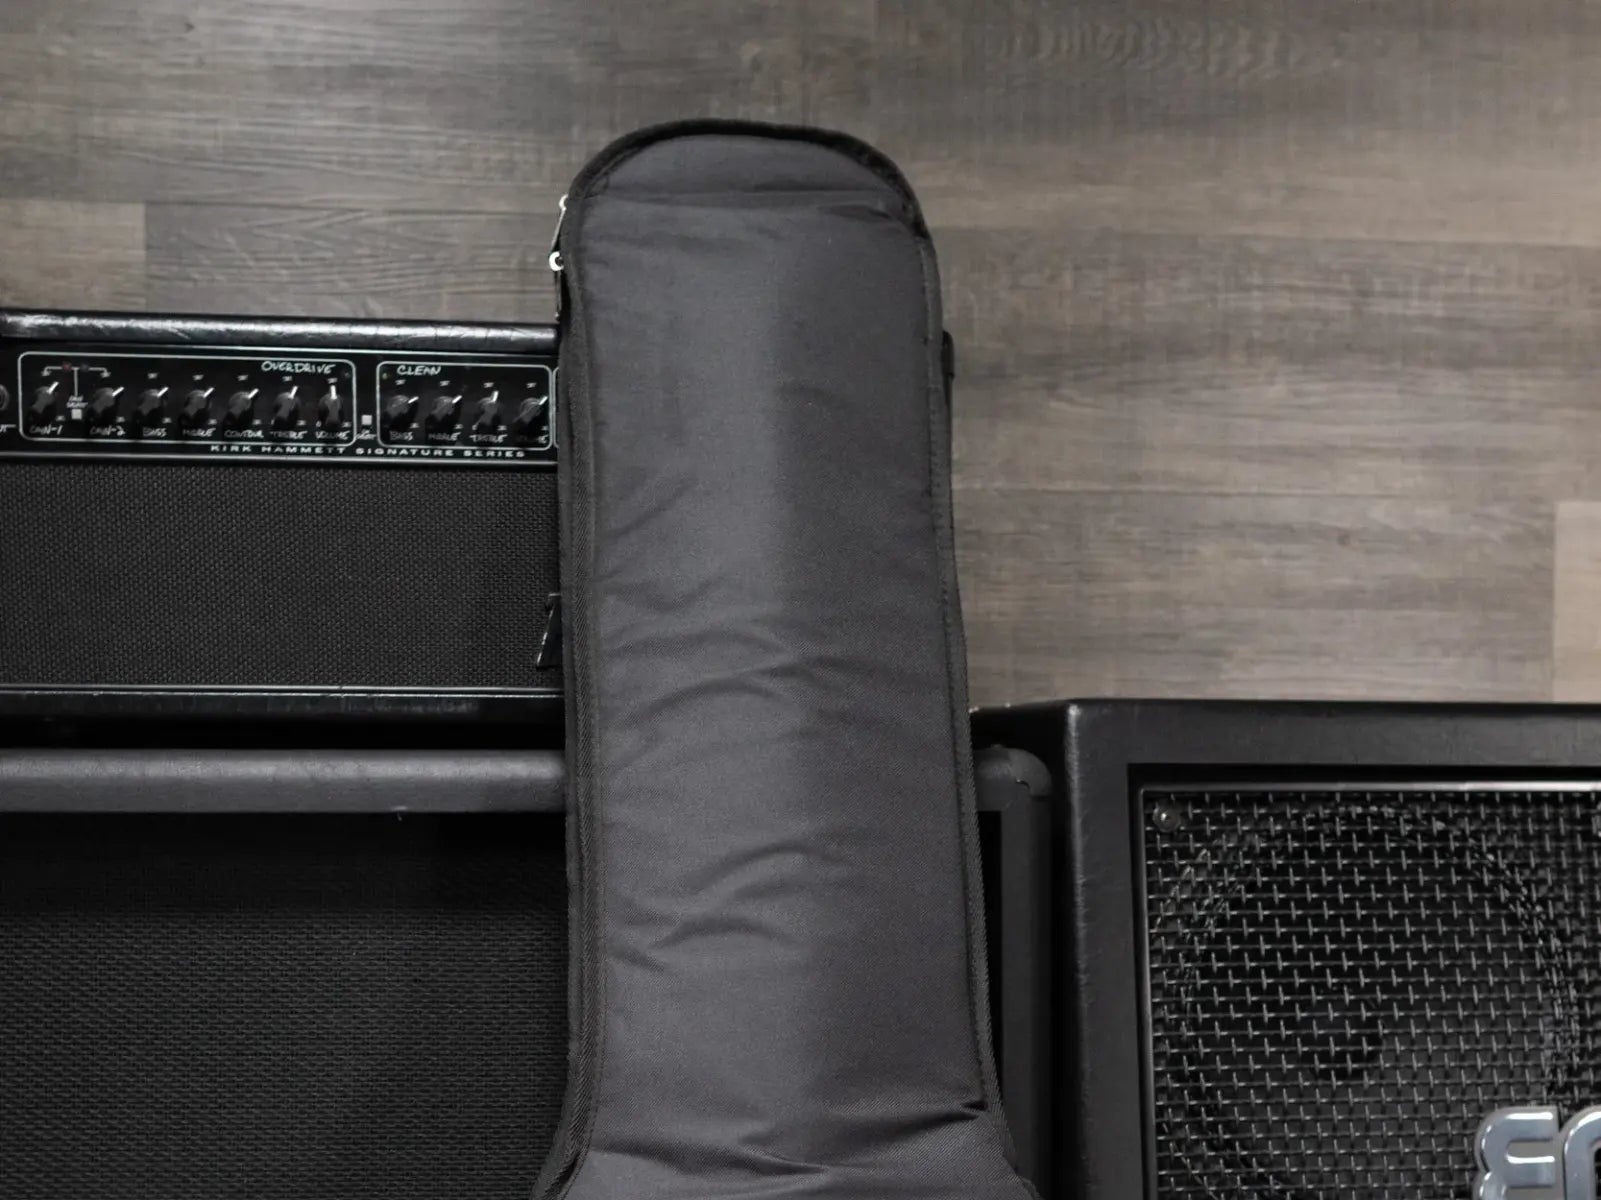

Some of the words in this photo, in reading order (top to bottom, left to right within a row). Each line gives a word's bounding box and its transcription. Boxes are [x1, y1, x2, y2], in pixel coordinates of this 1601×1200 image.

[261, 361, 336, 374] OVERDRIVE
[396, 365, 441, 376] CLEAN
[261, 446, 346, 454] HAMMETT
[355, 448, 454, 457] SIGNATURE
[463, 450, 526, 458] SERIES
